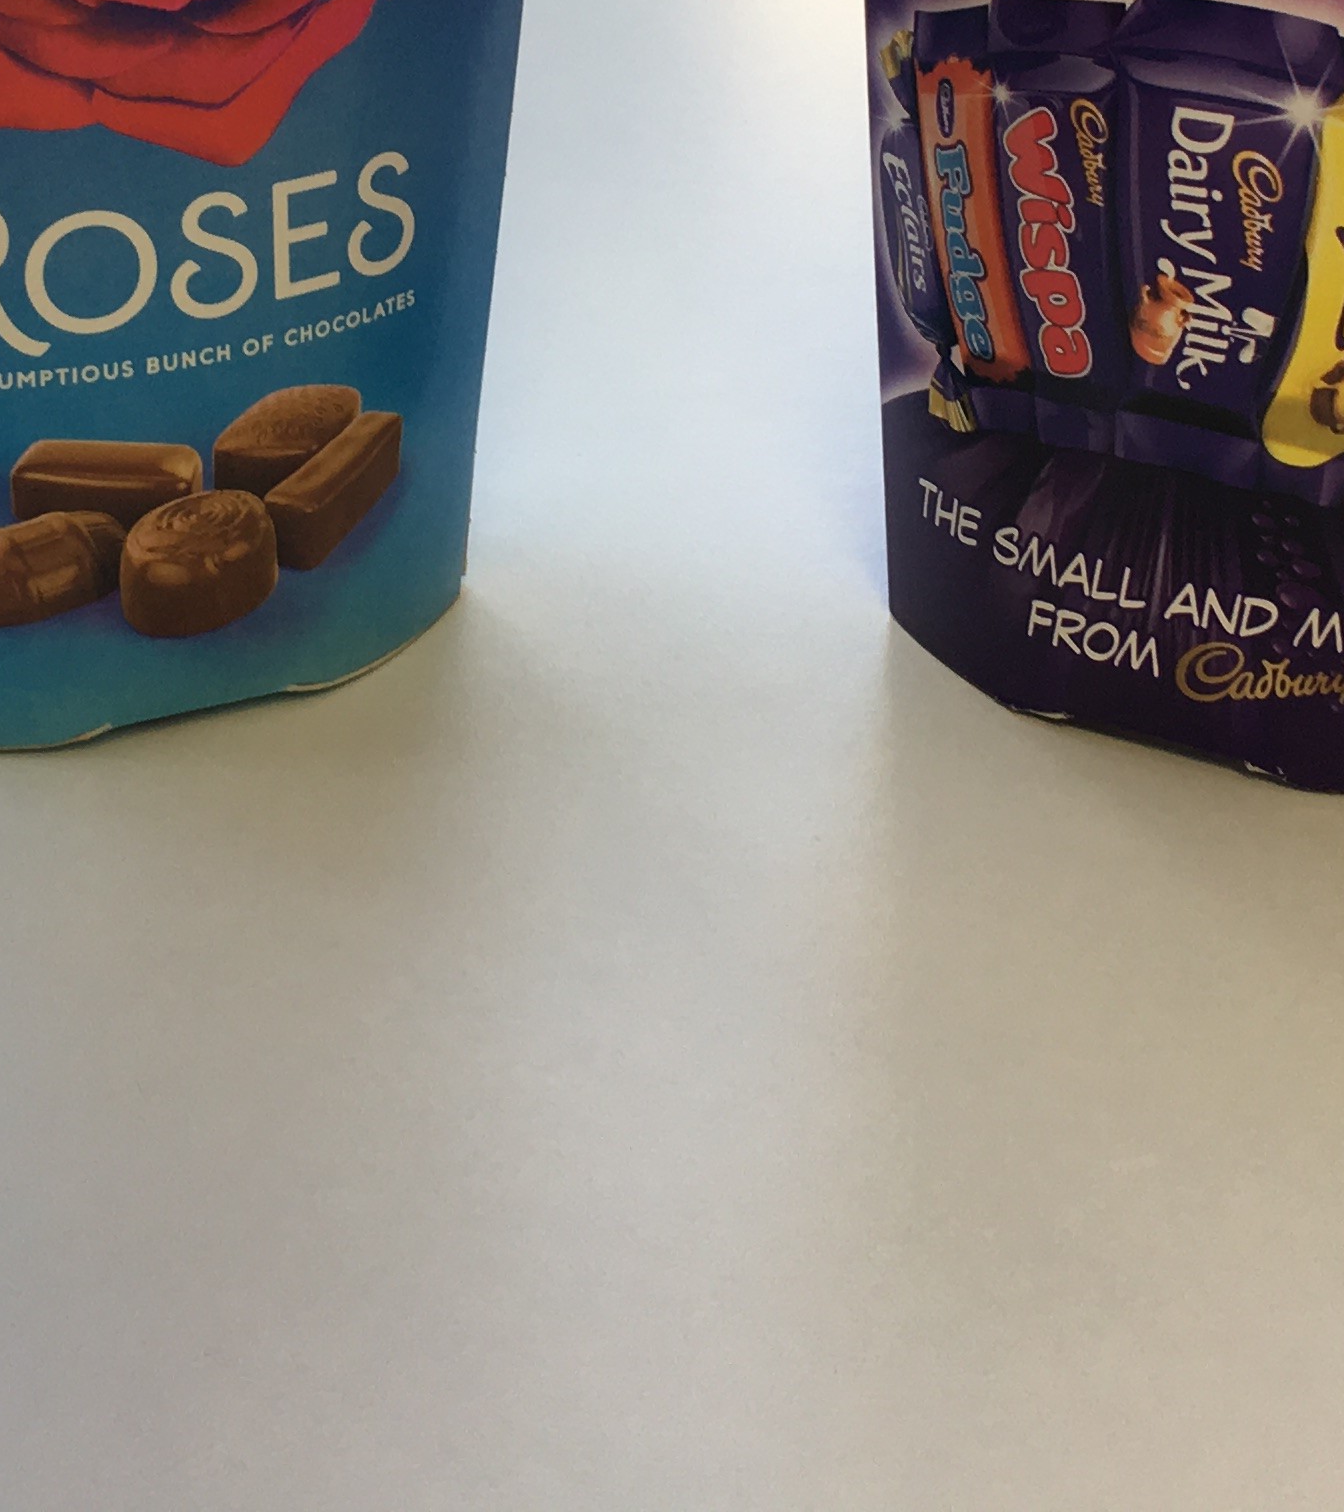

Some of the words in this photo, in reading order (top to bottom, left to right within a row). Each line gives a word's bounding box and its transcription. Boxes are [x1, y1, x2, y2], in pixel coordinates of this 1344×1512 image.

[1069, 98, 1109, 207] Cadbury
[1160, 106, 1235, 265] Dairy
[1232, 150, 1284, 272] Cadbury
[935, 144, 994, 362] Fudge
[1004, 107, 1092, 378] Wispa
[146, 343, 233, 375] BUNCH
[243, 335, 275, 357] OF
[284, 289, 417, 346] CHOCOLATES
[1161, 260, 1234, 390] Milk
[918, 478, 982, 547] THE
[993, 526, 1147, 610] SMALL
[1163, 582, 1279, 638] AND
[1027, 599, 1161, 678] FROM
